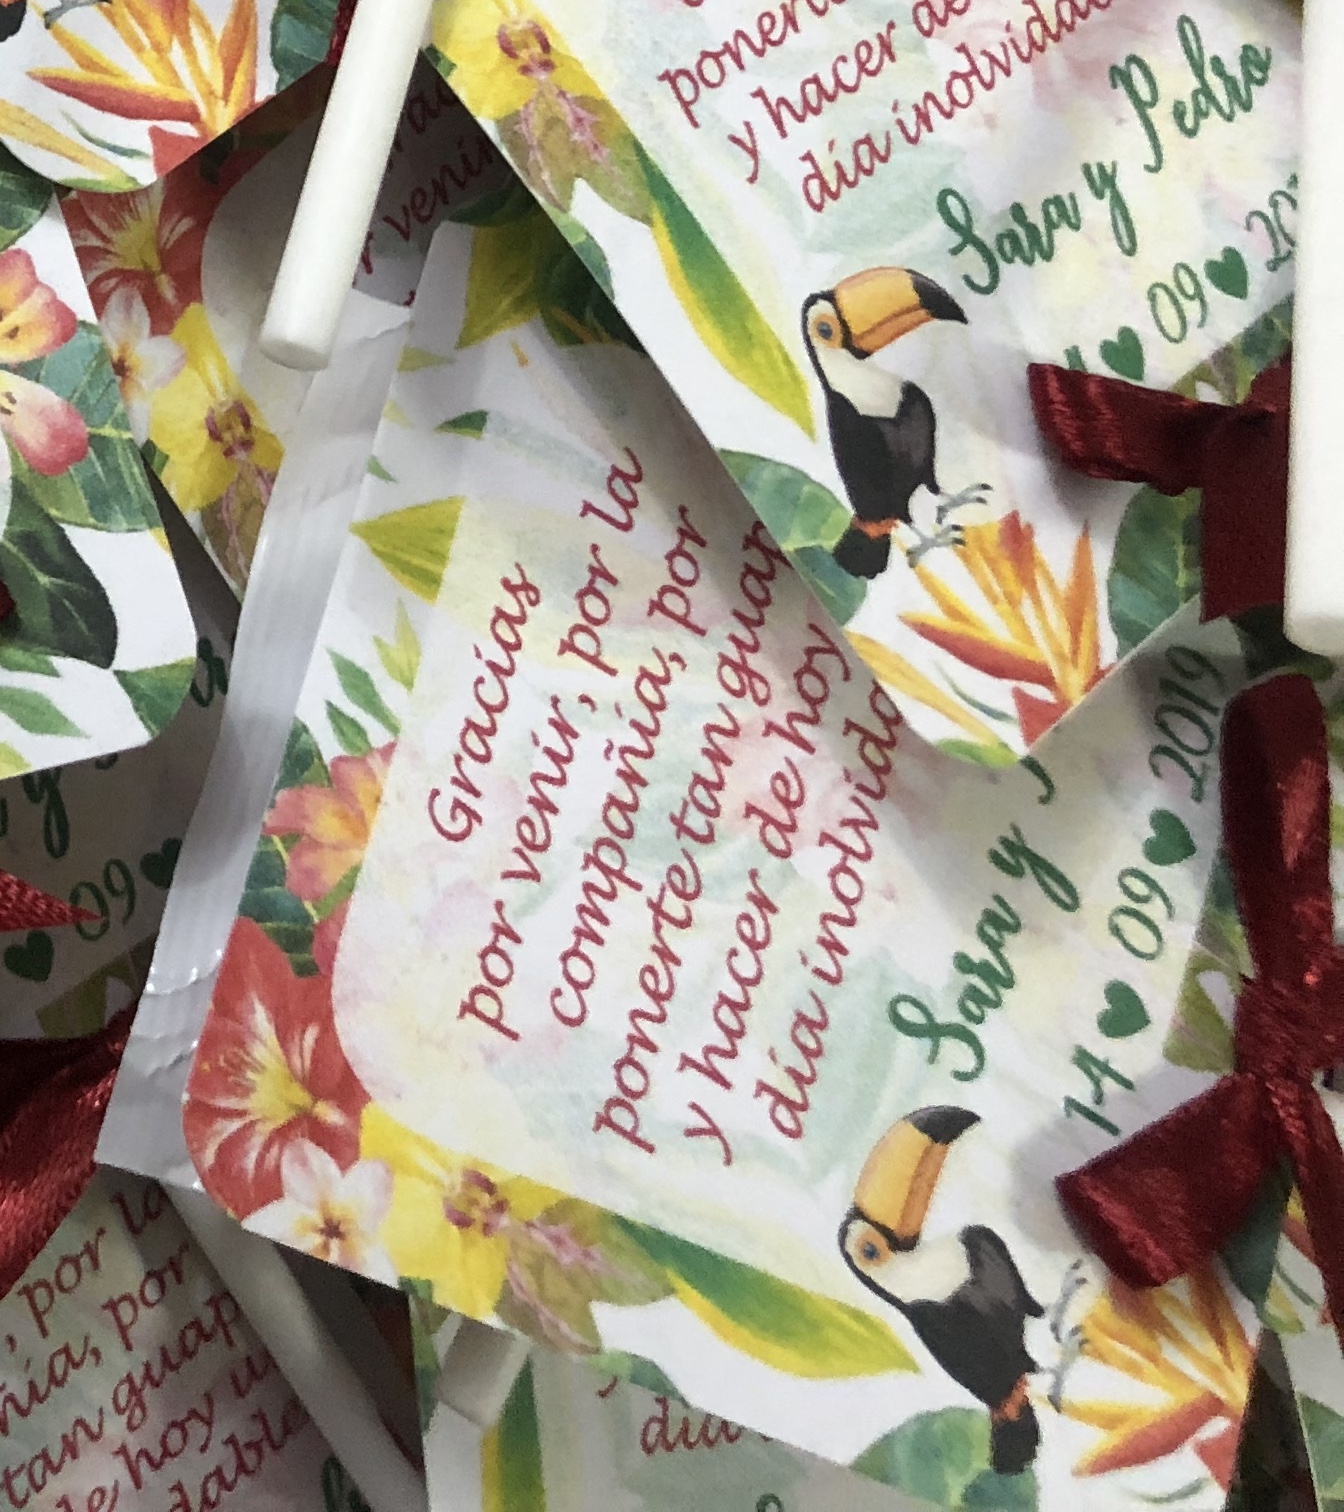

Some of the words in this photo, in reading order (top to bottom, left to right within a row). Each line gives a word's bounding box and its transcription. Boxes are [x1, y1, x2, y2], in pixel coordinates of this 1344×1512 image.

[1108, 14, 1273, 174] Pedro
[936, 188, 1080, 291] Sara
[1082, 162, 1138, 257] y
[580, 446, 644, 532] la
[557, 543, 619, 676] por
[647, 504, 707, 637] por
[428, 562, 540, 842] Gracias
[501, 694, 597, 883] venir,
[593, 851, 702, 1154] ponerte
[669, 704, 741, 845] tan
[1062, 1045, 1134, 1136] 14
[1109, 869, 1179, 963] 09
[1148, 643, 1227, 802] 2019
[457, 899, 523, 1042] por
[886, 895, 1025, 1084] Sara
[112, 1392, 214, 1491] hoy
